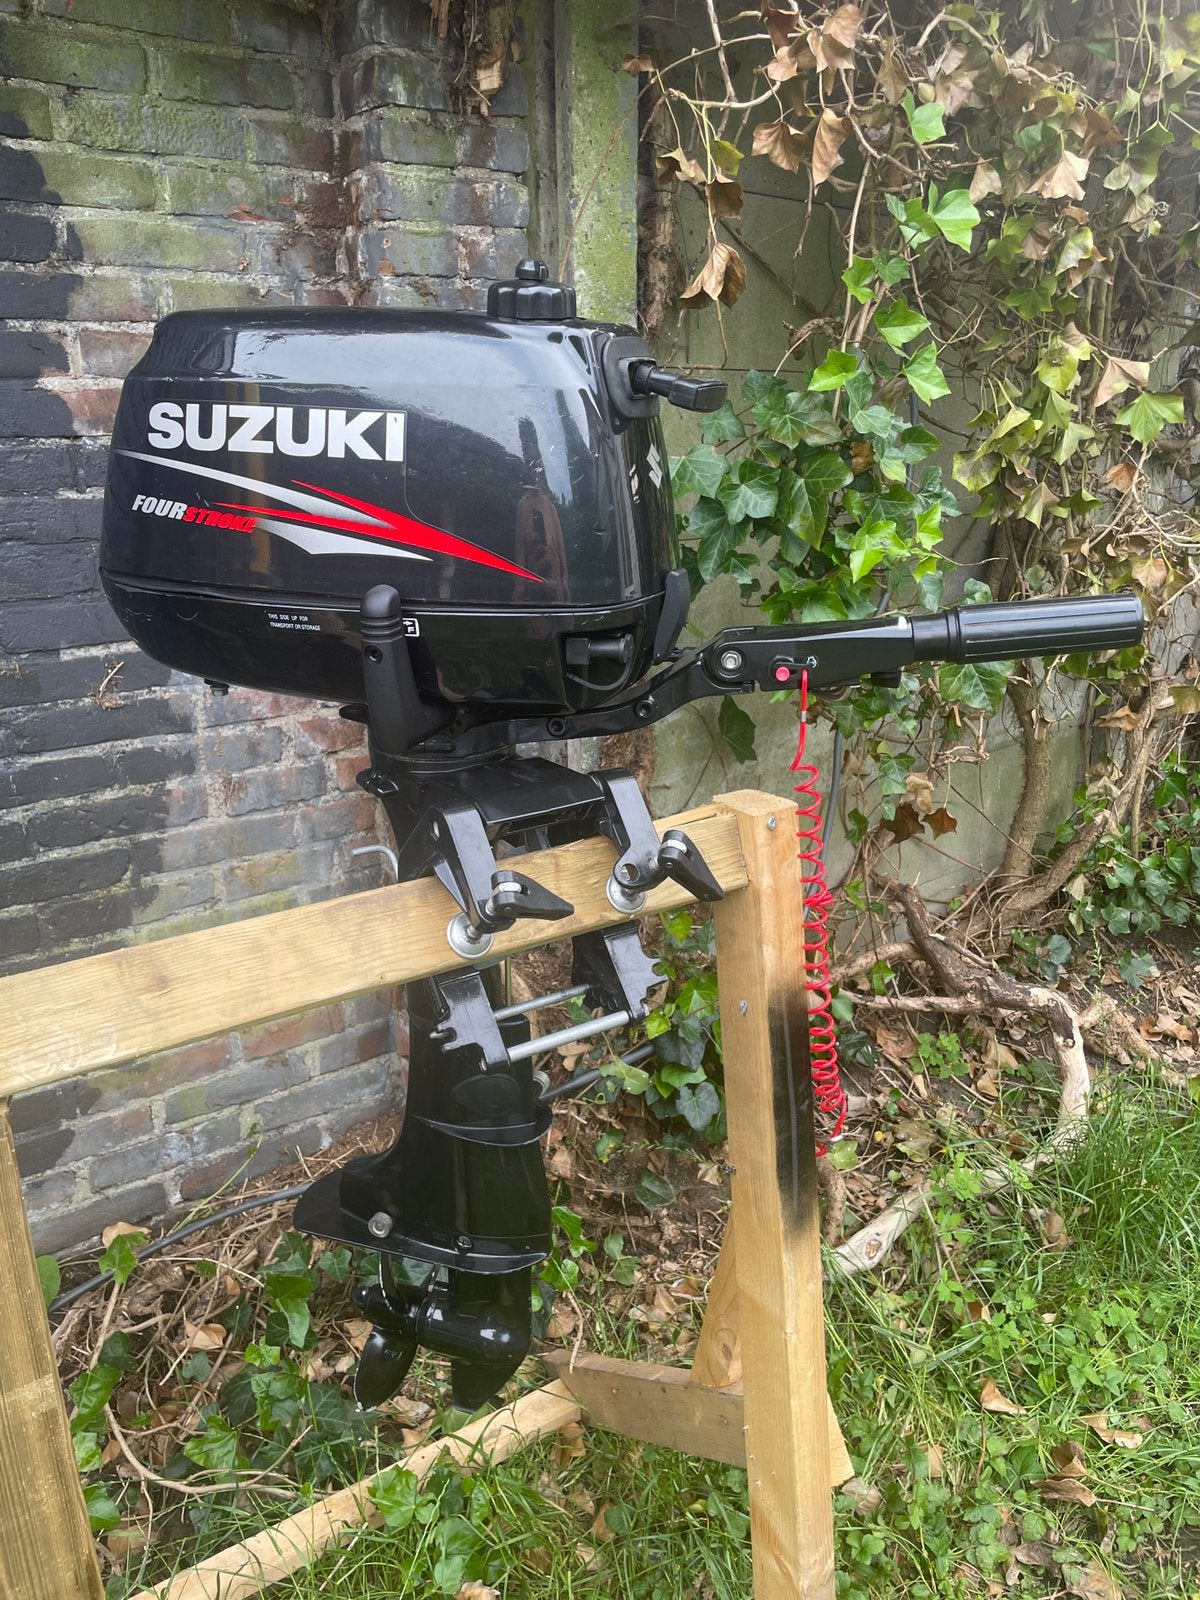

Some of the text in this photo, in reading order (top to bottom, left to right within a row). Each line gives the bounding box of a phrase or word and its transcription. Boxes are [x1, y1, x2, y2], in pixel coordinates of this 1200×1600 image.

[148, 401, 406, 463] SUZUKI
[270, 621, 294, 629] TRANSPORT
[301, 624, 321, 632] STORAGE
